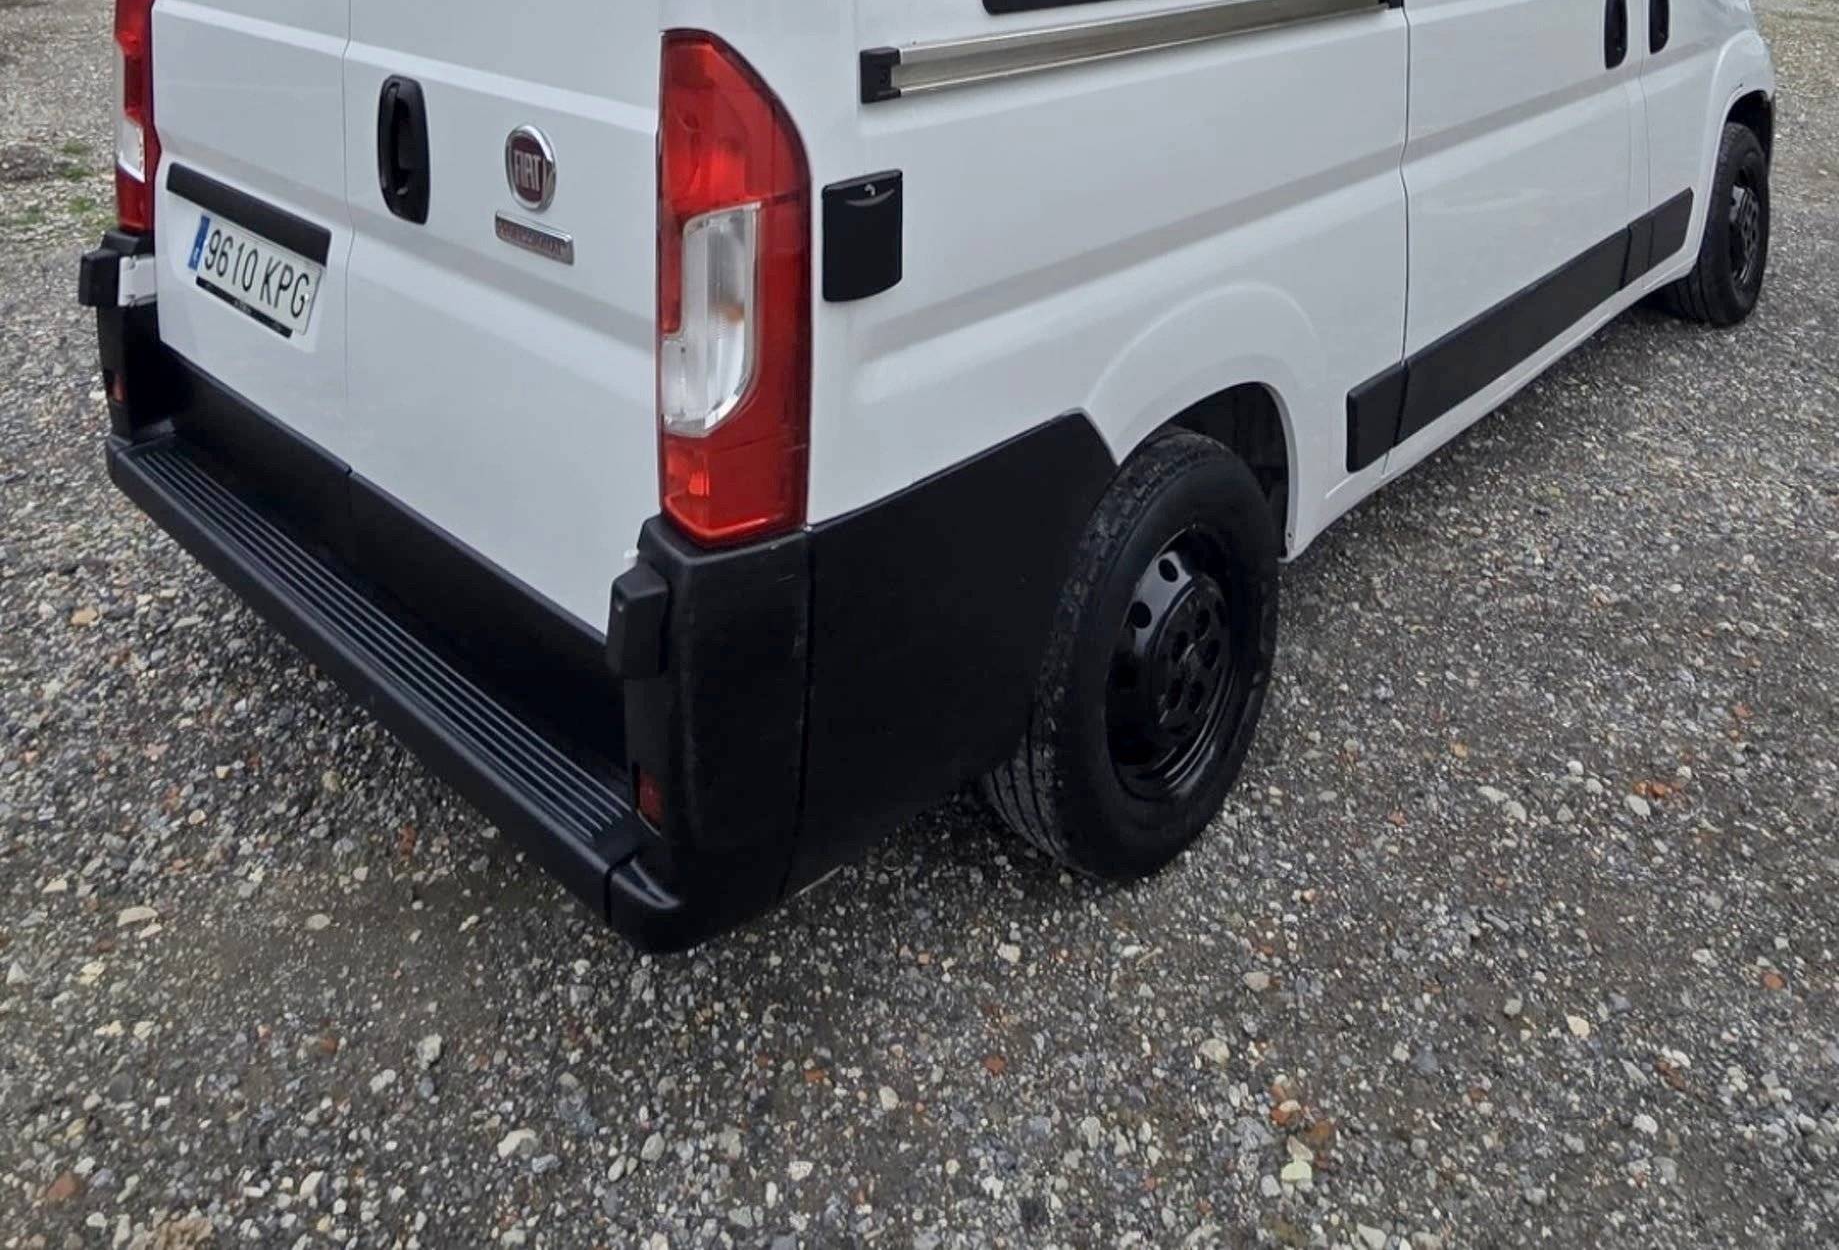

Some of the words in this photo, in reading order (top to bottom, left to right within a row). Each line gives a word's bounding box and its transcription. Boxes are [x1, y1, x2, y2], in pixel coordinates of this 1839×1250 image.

[513, 150, 542, 192] FIAT
[204, 228, 259, 292] 9610
[259, 255, 310, 319] KPG
